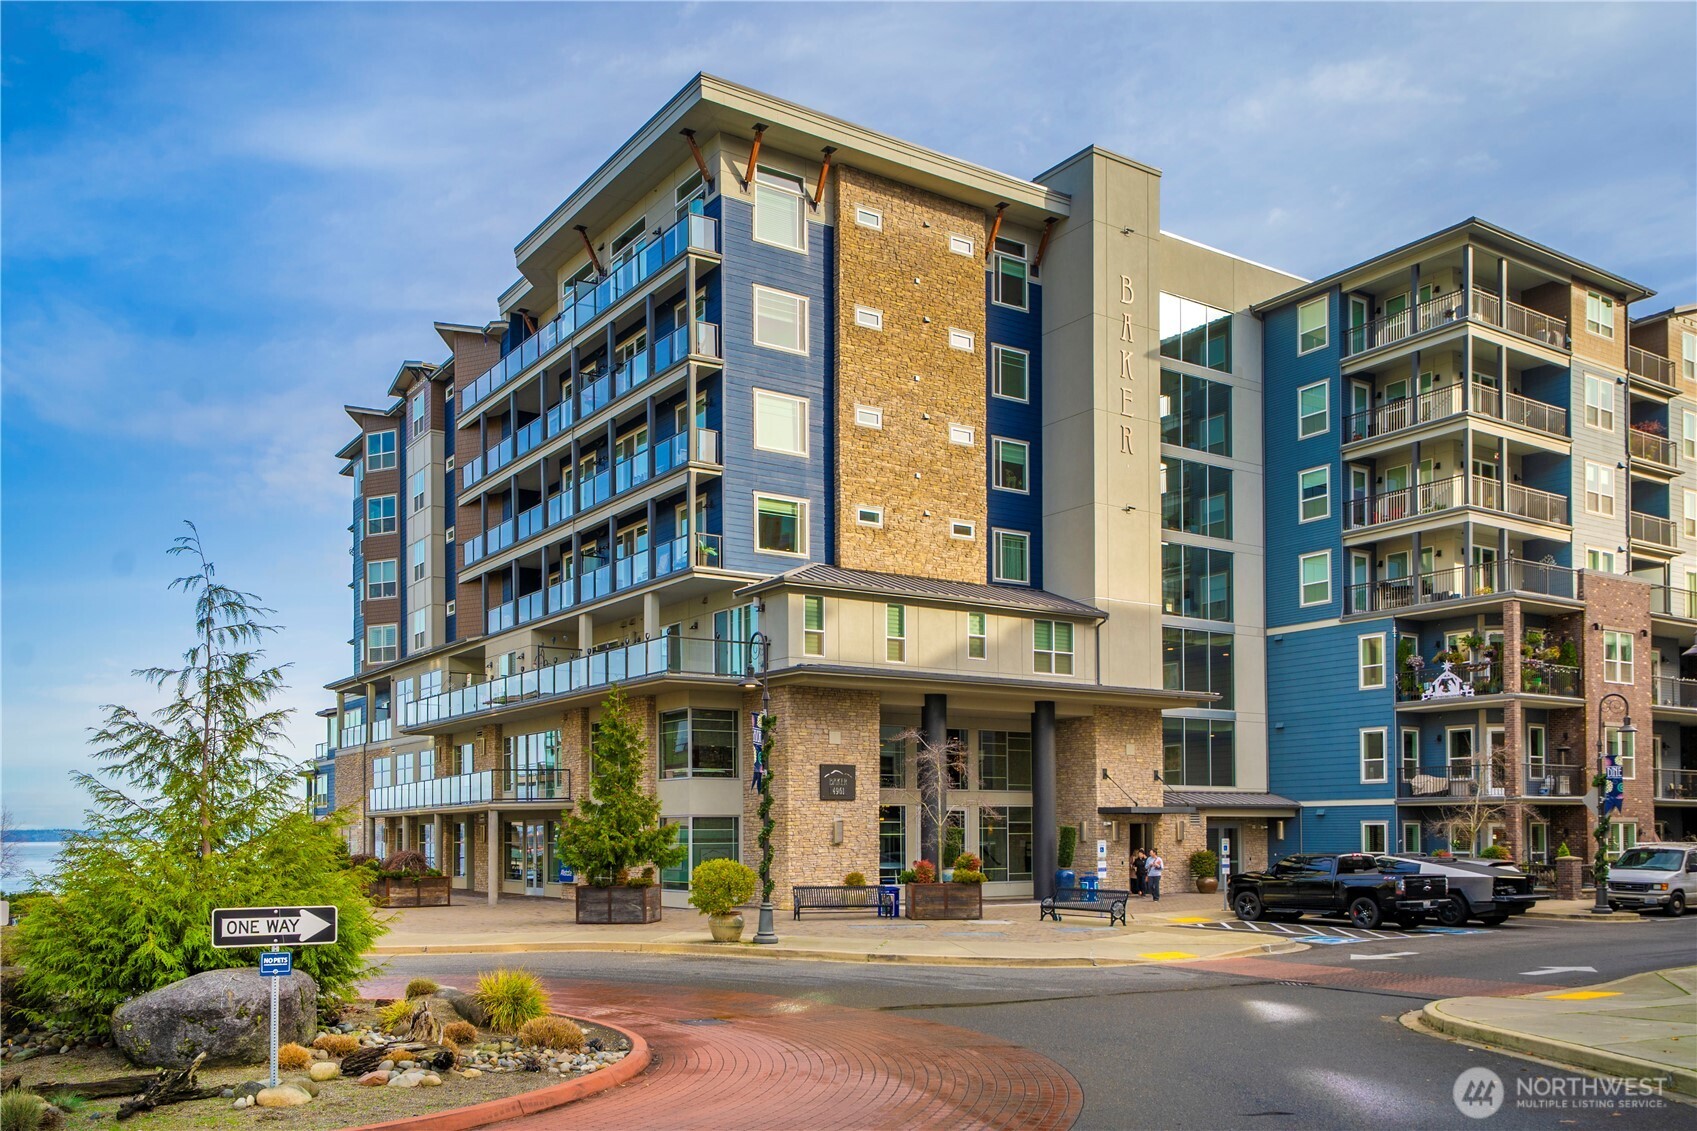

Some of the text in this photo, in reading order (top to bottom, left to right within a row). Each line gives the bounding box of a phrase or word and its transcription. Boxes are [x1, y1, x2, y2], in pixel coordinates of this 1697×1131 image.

[1119, 274, 1134, 455] BAKER
[226, 919, 300, 935] ONE WAY
